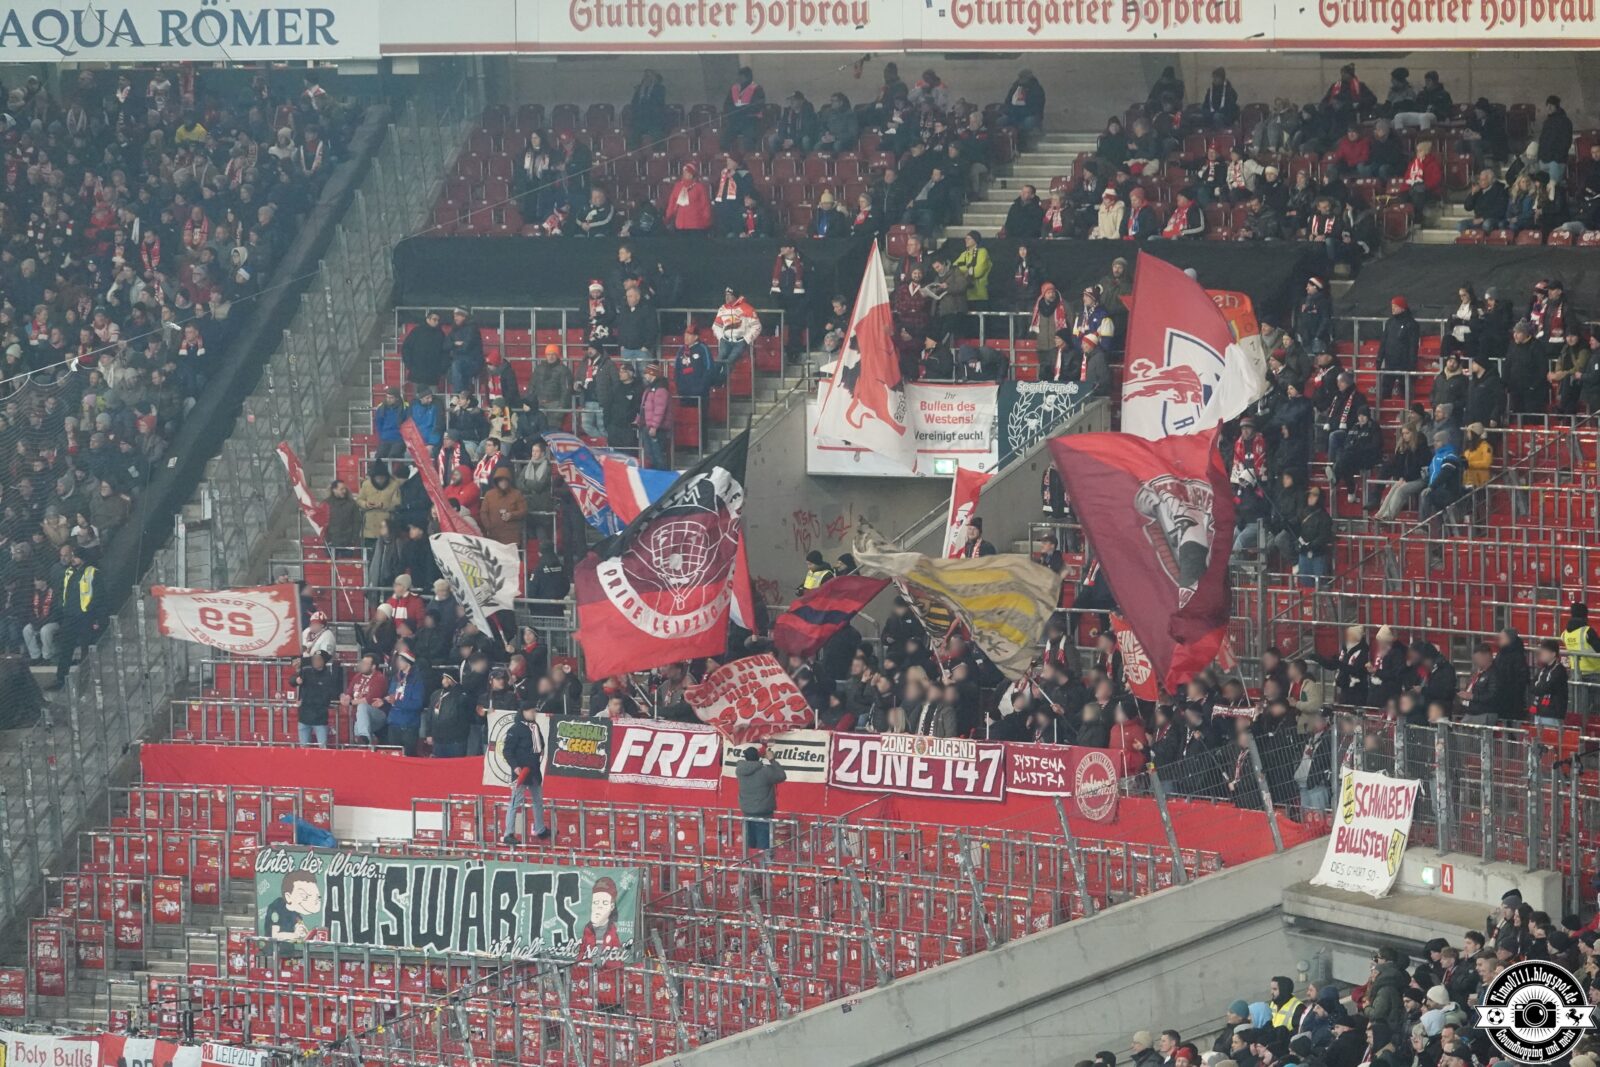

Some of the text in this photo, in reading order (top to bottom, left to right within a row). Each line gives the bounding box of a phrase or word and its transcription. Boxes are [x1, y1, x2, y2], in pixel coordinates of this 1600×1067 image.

[0, 0, 340, 57] AQUA RÖMER
[1016, 380, 1079, 395] Sportfreunde
[920, 401, 976, 412] Bullen des
[924, 413, 974, 425] Westens!
[914, 430, 983, 443] Vereinigt euch!
[603, 568, 644, 619] PRIDE
[567, 738, 597, 754] GEGEN
[610, 727, 720, 778] FRP
[881, 735, 976, 760] ZONE JUGEND
[834, 738, 999, 793] ZONE 147
[1013, 753, 1066, 771] SYSTEMA
[1354, 782, 1416, 820] SCHWABEN
[1335, 826, 1389, 862] BALLISTEN
[254, 847, 295, 874] Unter
[300, 850, 323, 874] der
[1443, 866, 1452, 892] 4
[325, 860, 582, 954] AUSWÄRTS
[14, 1040, 48, 1067] Holy
[54, 1047, 93, 1067] Bulls
[202, 1043, 256, 1066] RB LEIPZIG
